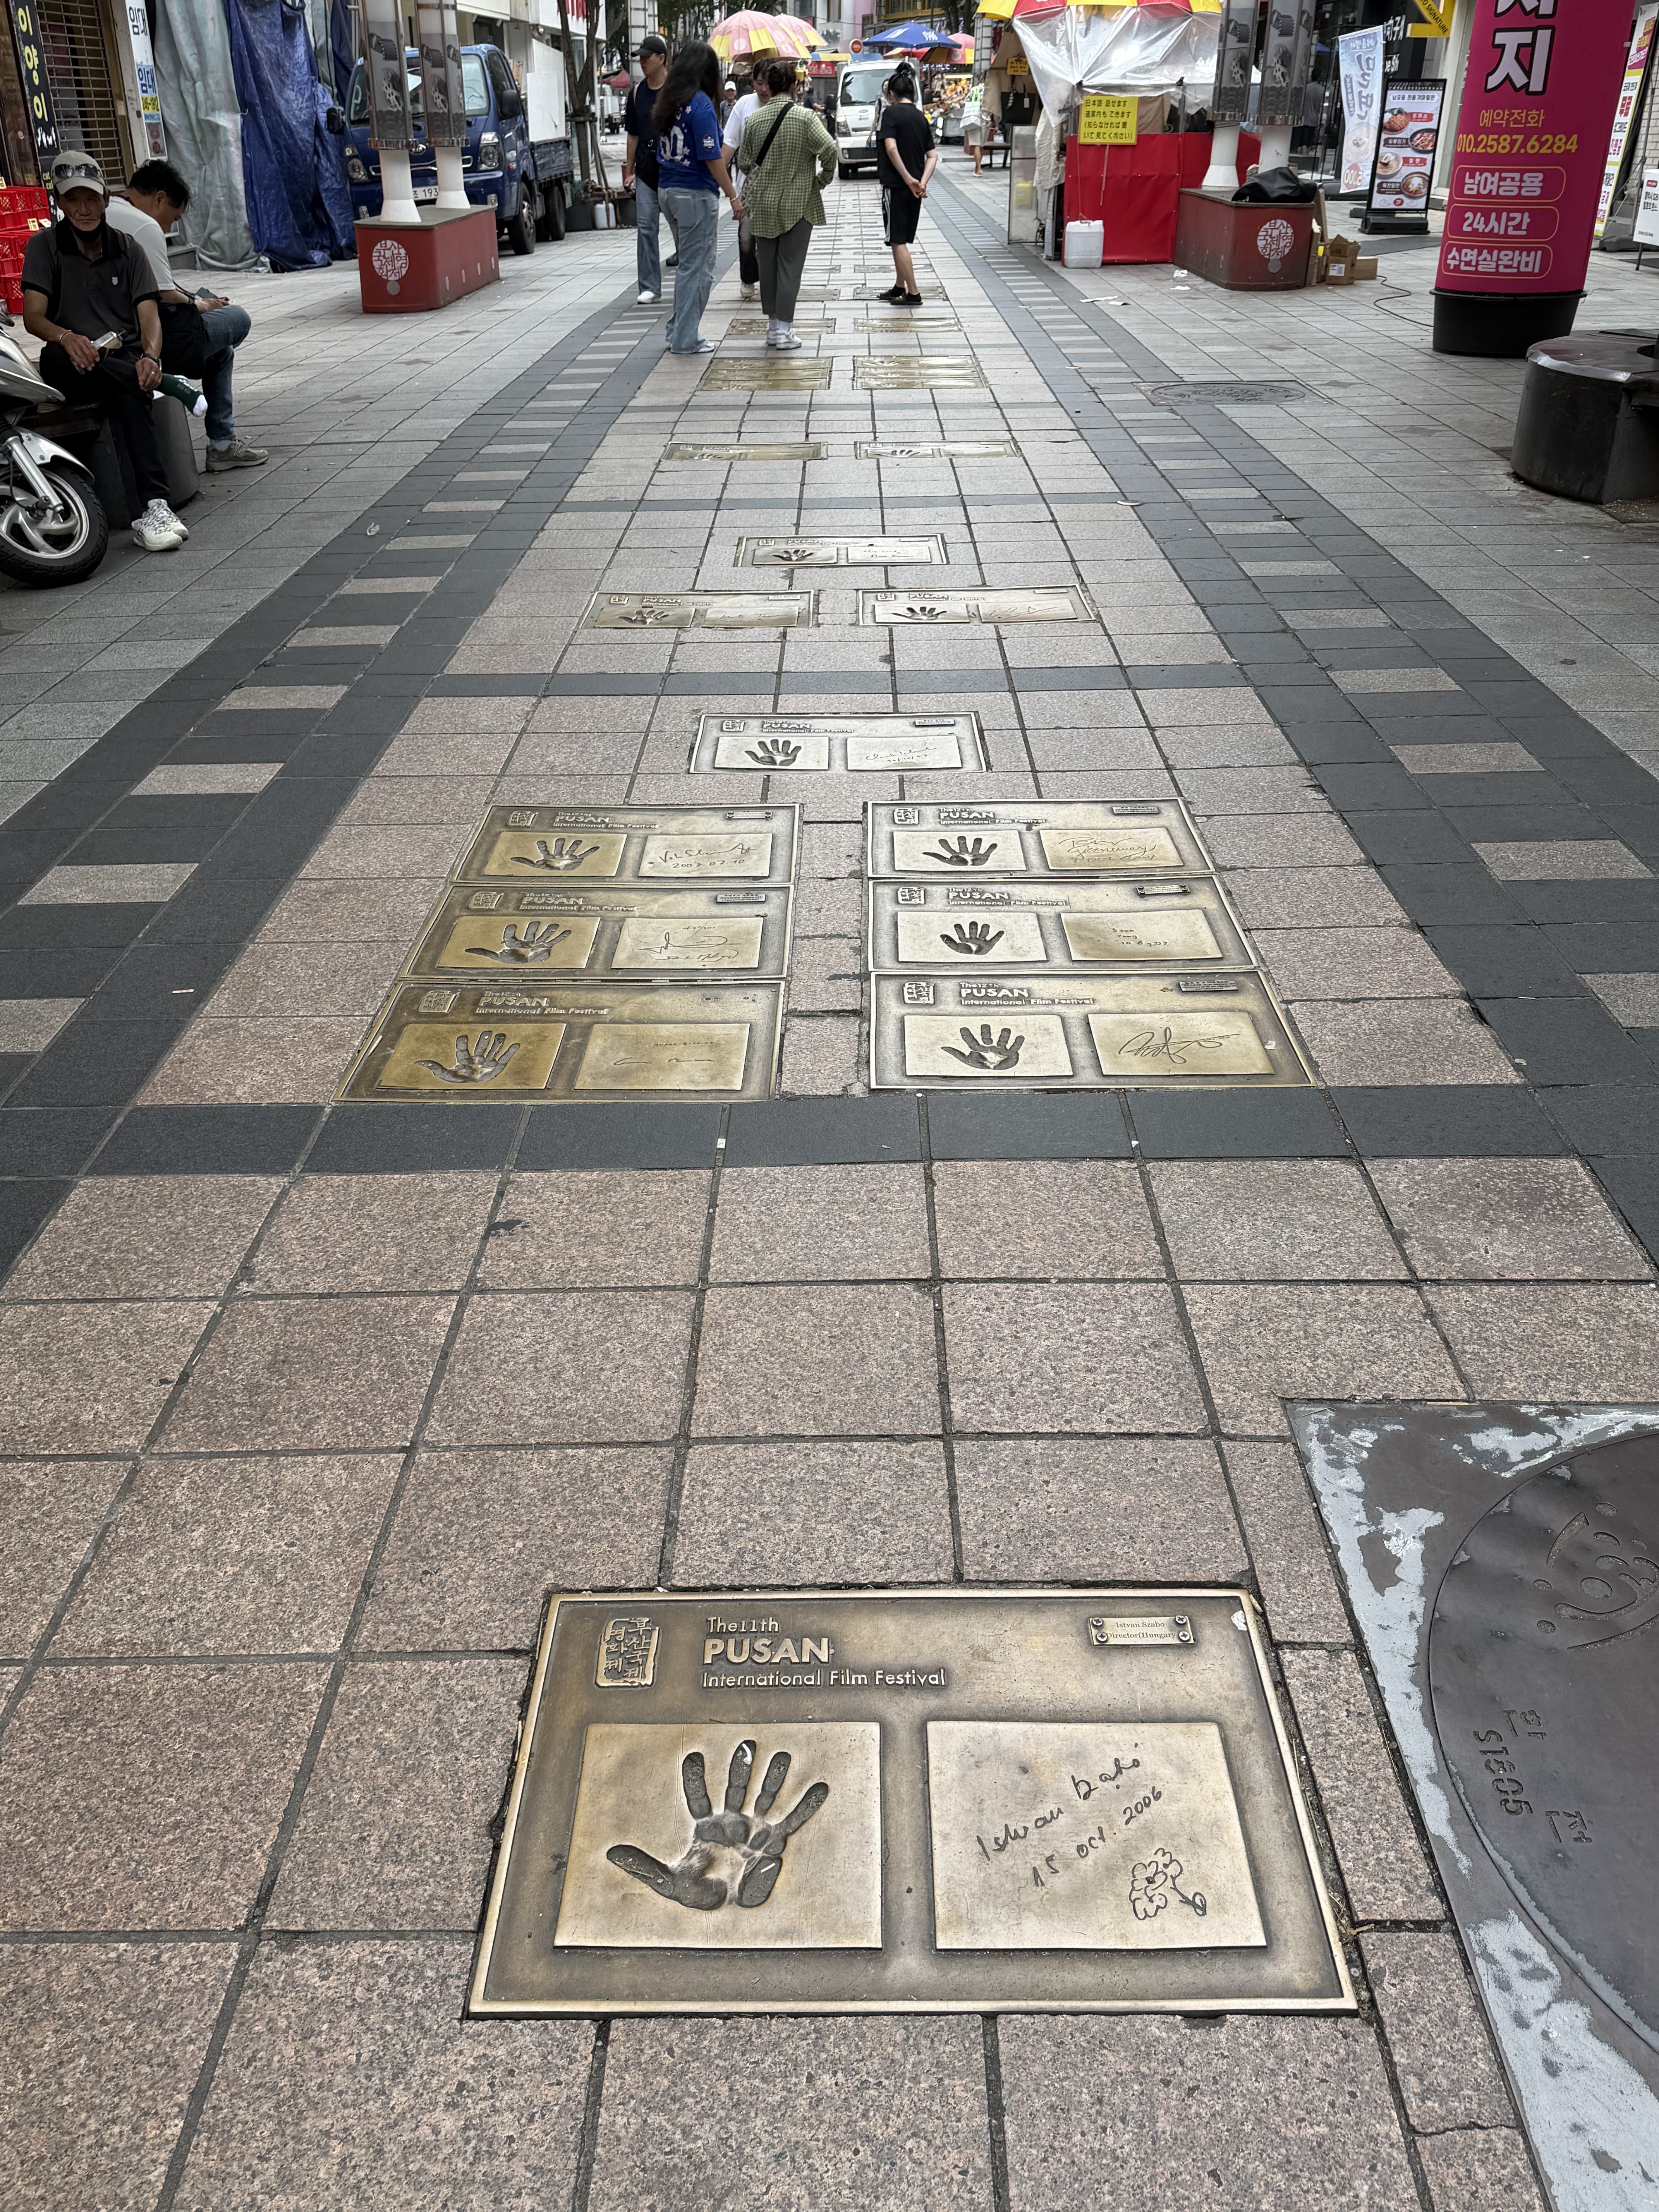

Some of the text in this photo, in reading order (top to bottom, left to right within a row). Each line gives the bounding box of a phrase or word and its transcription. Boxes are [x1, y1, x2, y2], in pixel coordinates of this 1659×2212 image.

[129, 6, 148, 36] 임대
[1425, 4, 1449, 35] SIGNATURE
[138, 67, 156, 94] 임대
[1479, 109, 1545, 127] 예약전화
[1457, 134, 1578, 154] 010.2587.6284
[1464, 172, 1544, 196] 남여공용
[1463, 211, 1530, 235] 24시간
[1447, 247, 1542, 273] 수면실완비
[478, 997, 549, 1006] PUSAN
[960, 989, 1029, 997] PUSAN
[703, 1637, 830, 1665] PUSAN
[702, 1670, 945, 1688] International Film Festival
[1546, 1809, 1592, 1843] 전
